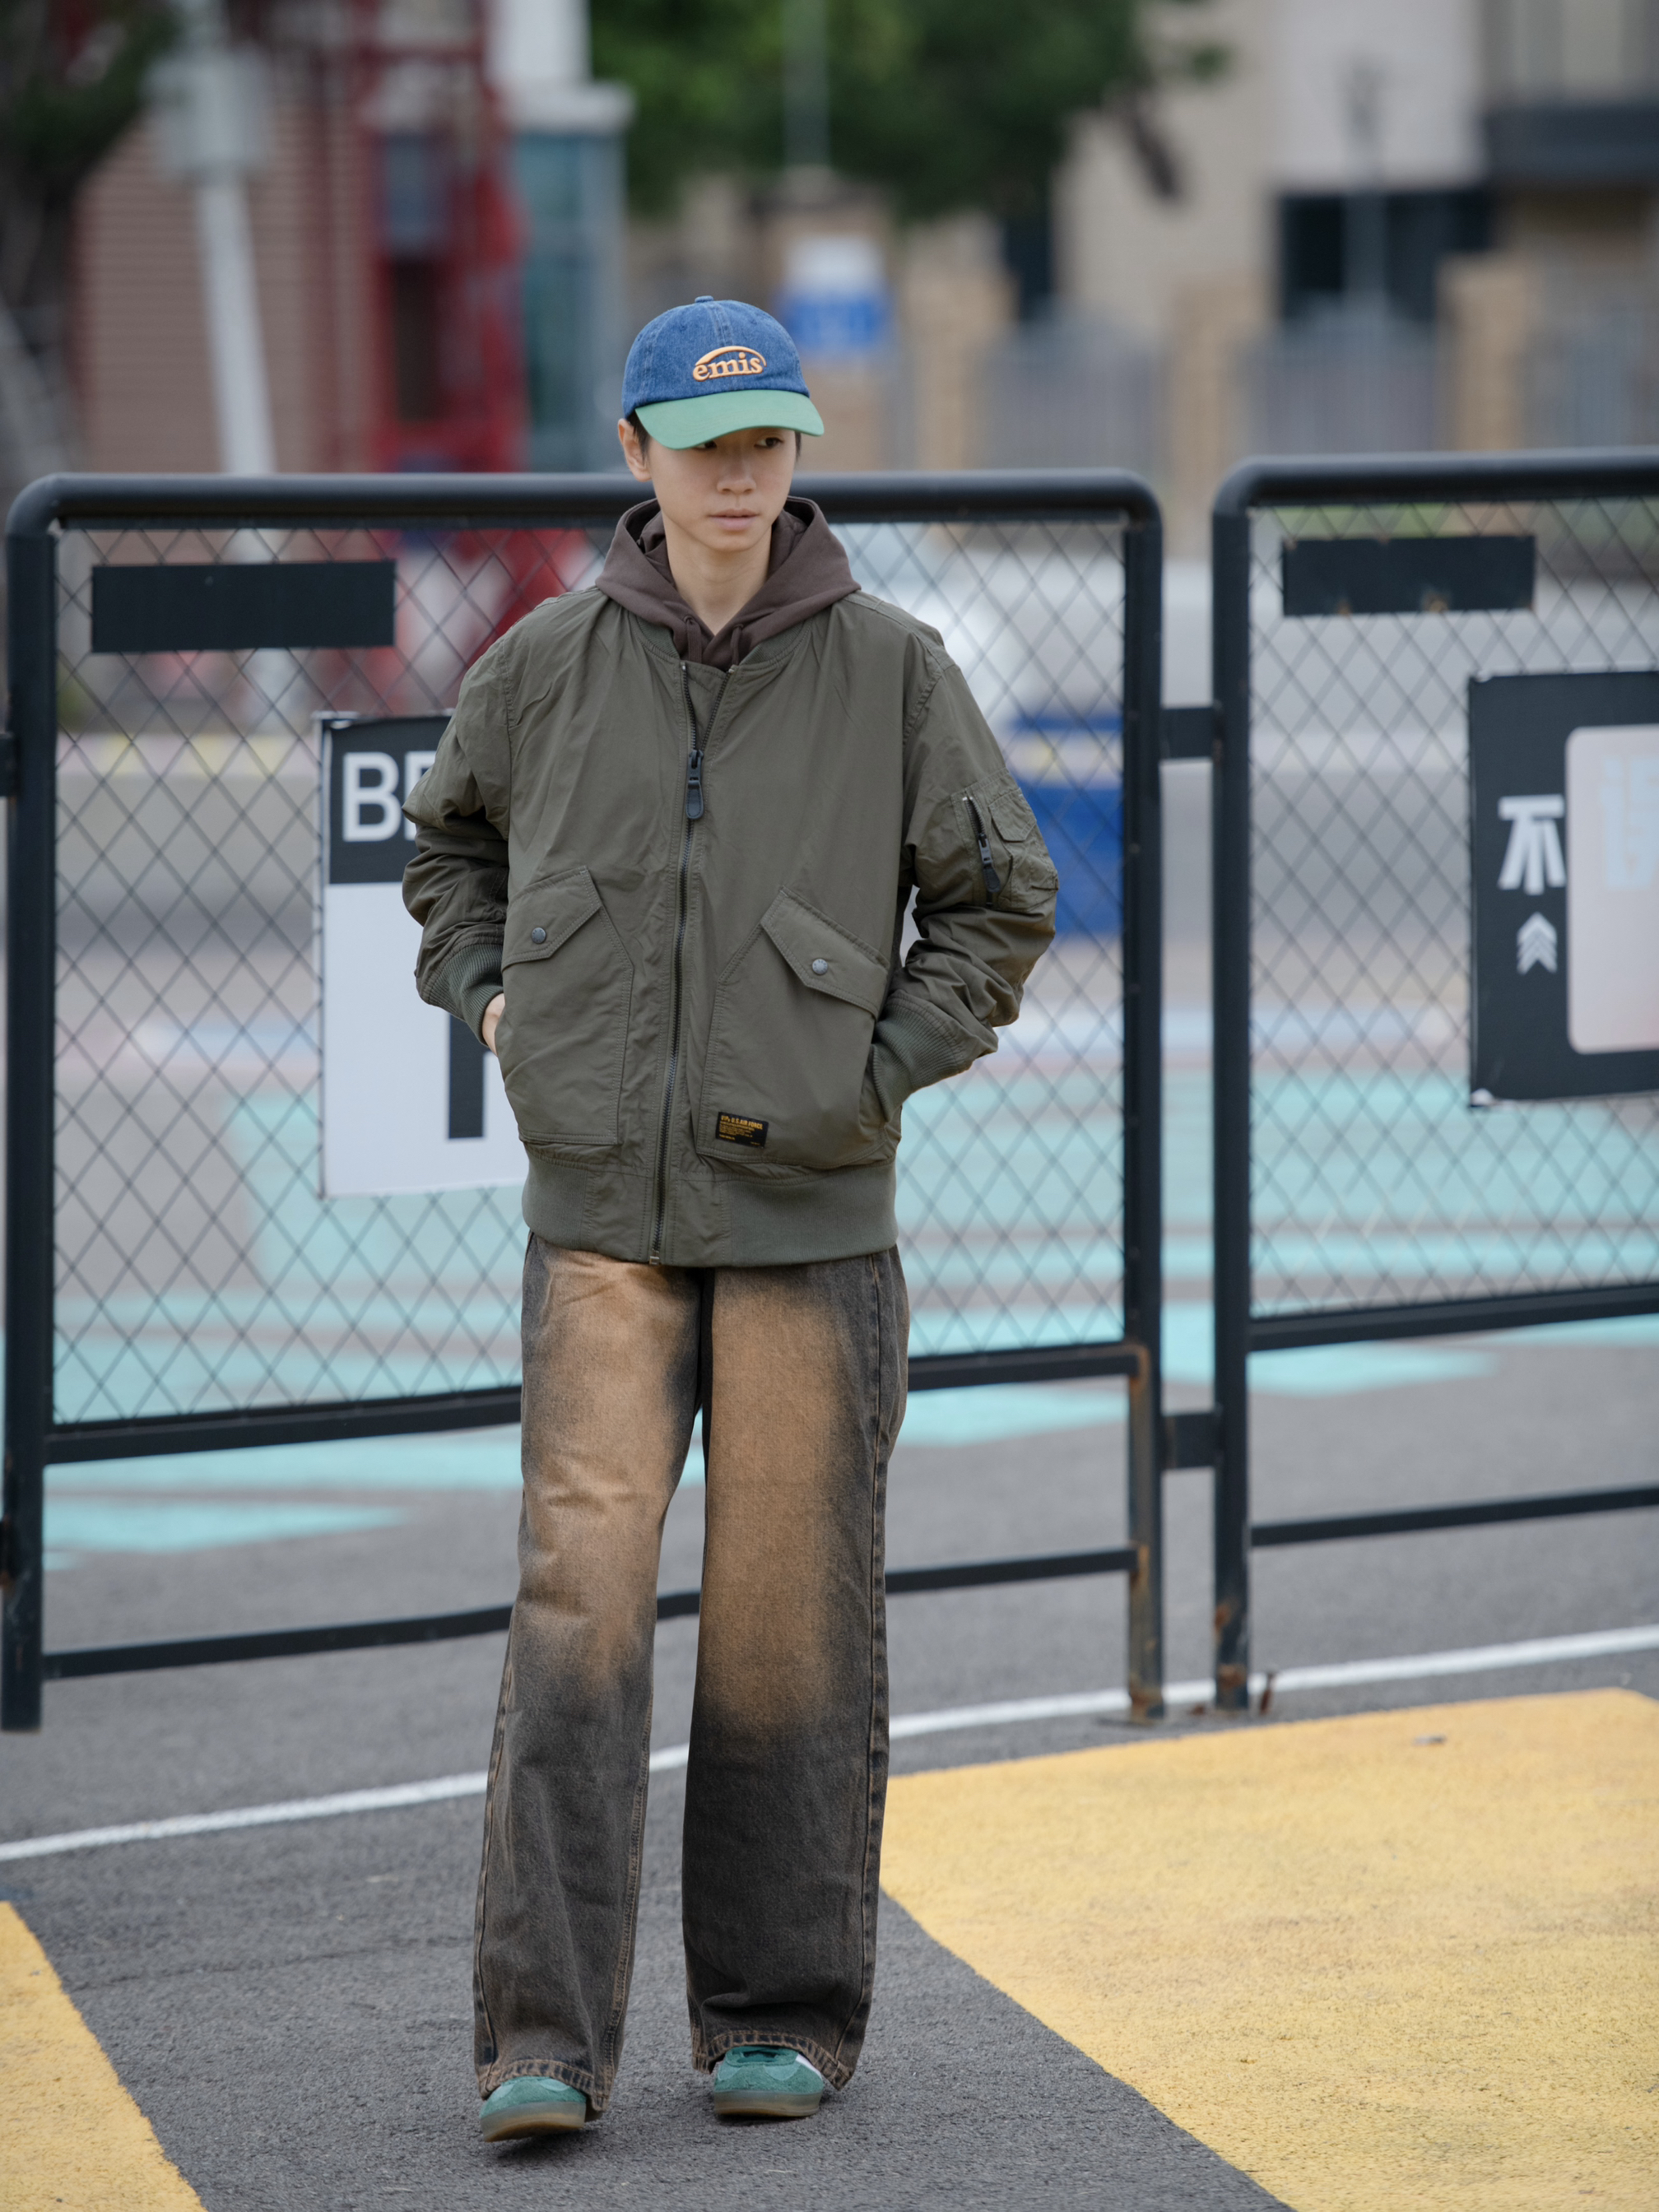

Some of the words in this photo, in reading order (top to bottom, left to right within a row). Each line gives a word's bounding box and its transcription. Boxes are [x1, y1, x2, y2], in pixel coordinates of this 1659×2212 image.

[693, 351, 764, 382] emis
[1499, 793, 1567, 895] 不
[748, 1121, 763, 1130] FORCE
